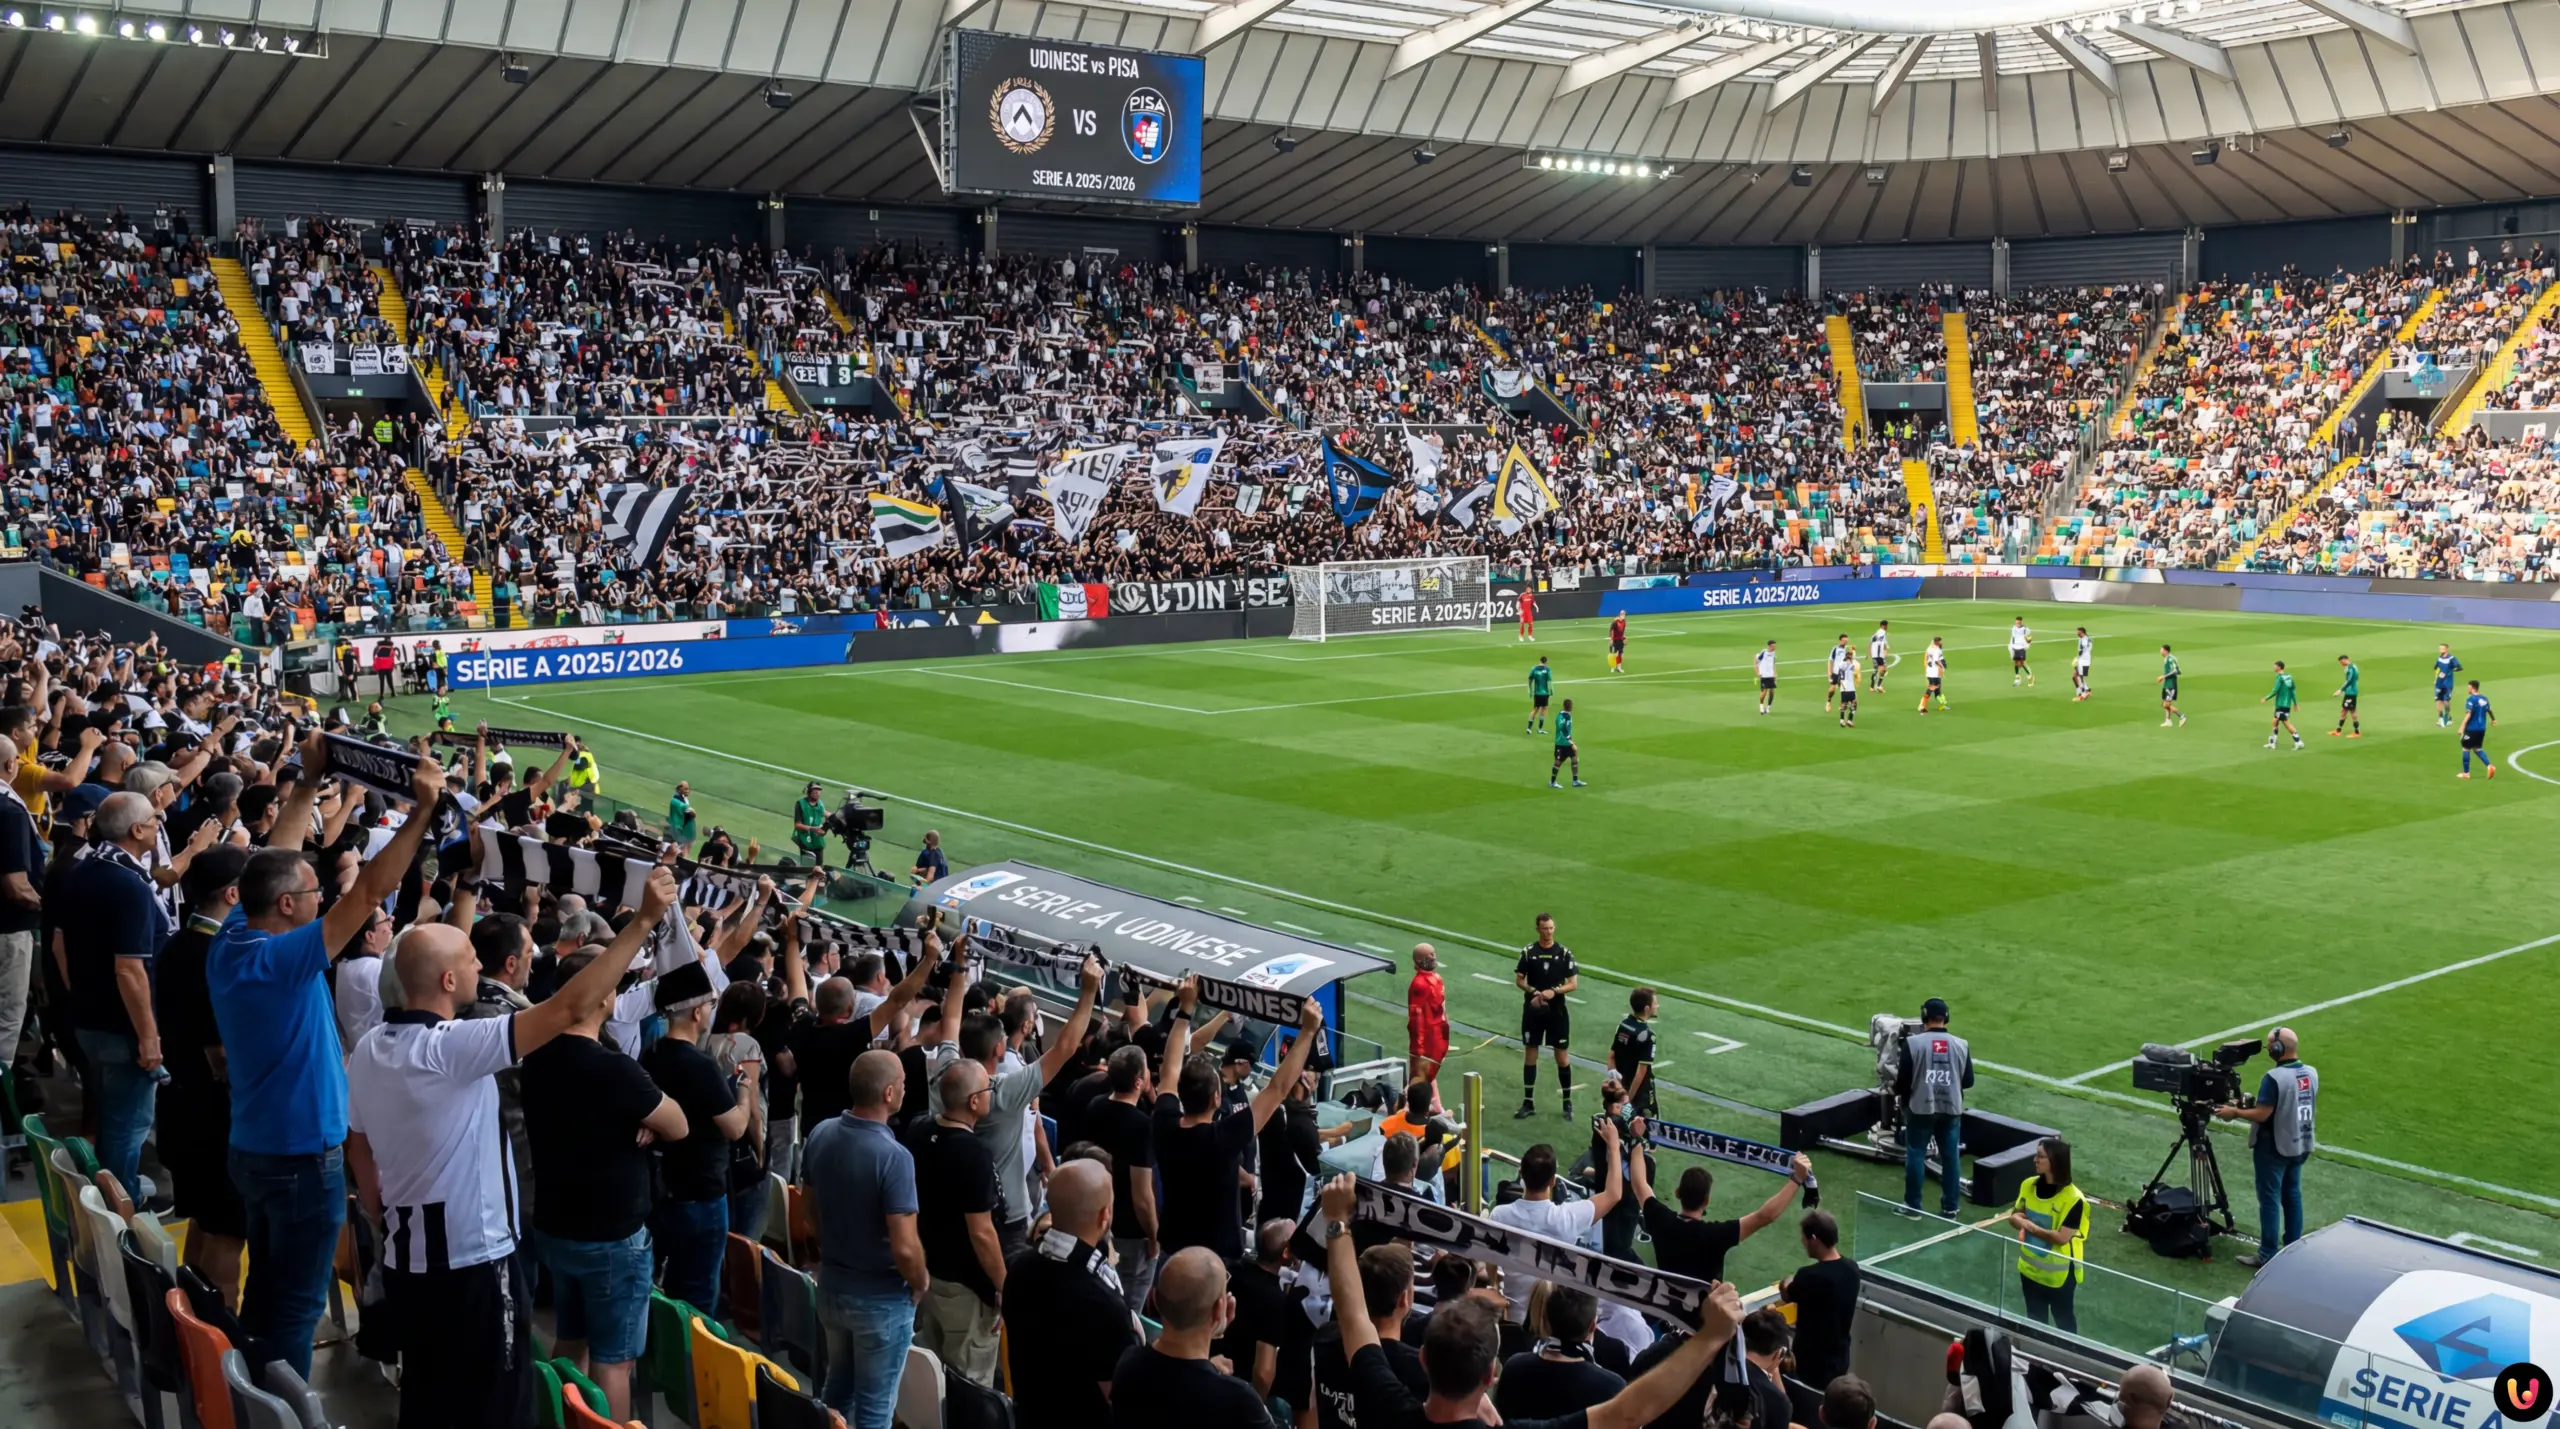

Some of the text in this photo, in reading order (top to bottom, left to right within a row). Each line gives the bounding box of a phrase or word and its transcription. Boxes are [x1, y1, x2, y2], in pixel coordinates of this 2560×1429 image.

[1030, 48, 1088, 73] UDINESE
[1108, 56, 1139, 79] PISA
[1129, 95, 1166, 113] PISA
[1072, 108, 1097, 136] VS
[1032, 169, 1136, 192] SERIE A 2025/2026
[1703, 584, 1820, 607] SERIE A 2025/2026
[1371, 600, 1514, 625] SERIE A 2025/2026
[456, 648, 684, 682] SERIE A 2025/2026
[998, 886, 1263, 967] SERIE A UDINESE
[1201, 977, 1305, 1025] UDINES
[2350, 1367, 2472, 1429] SERIE
